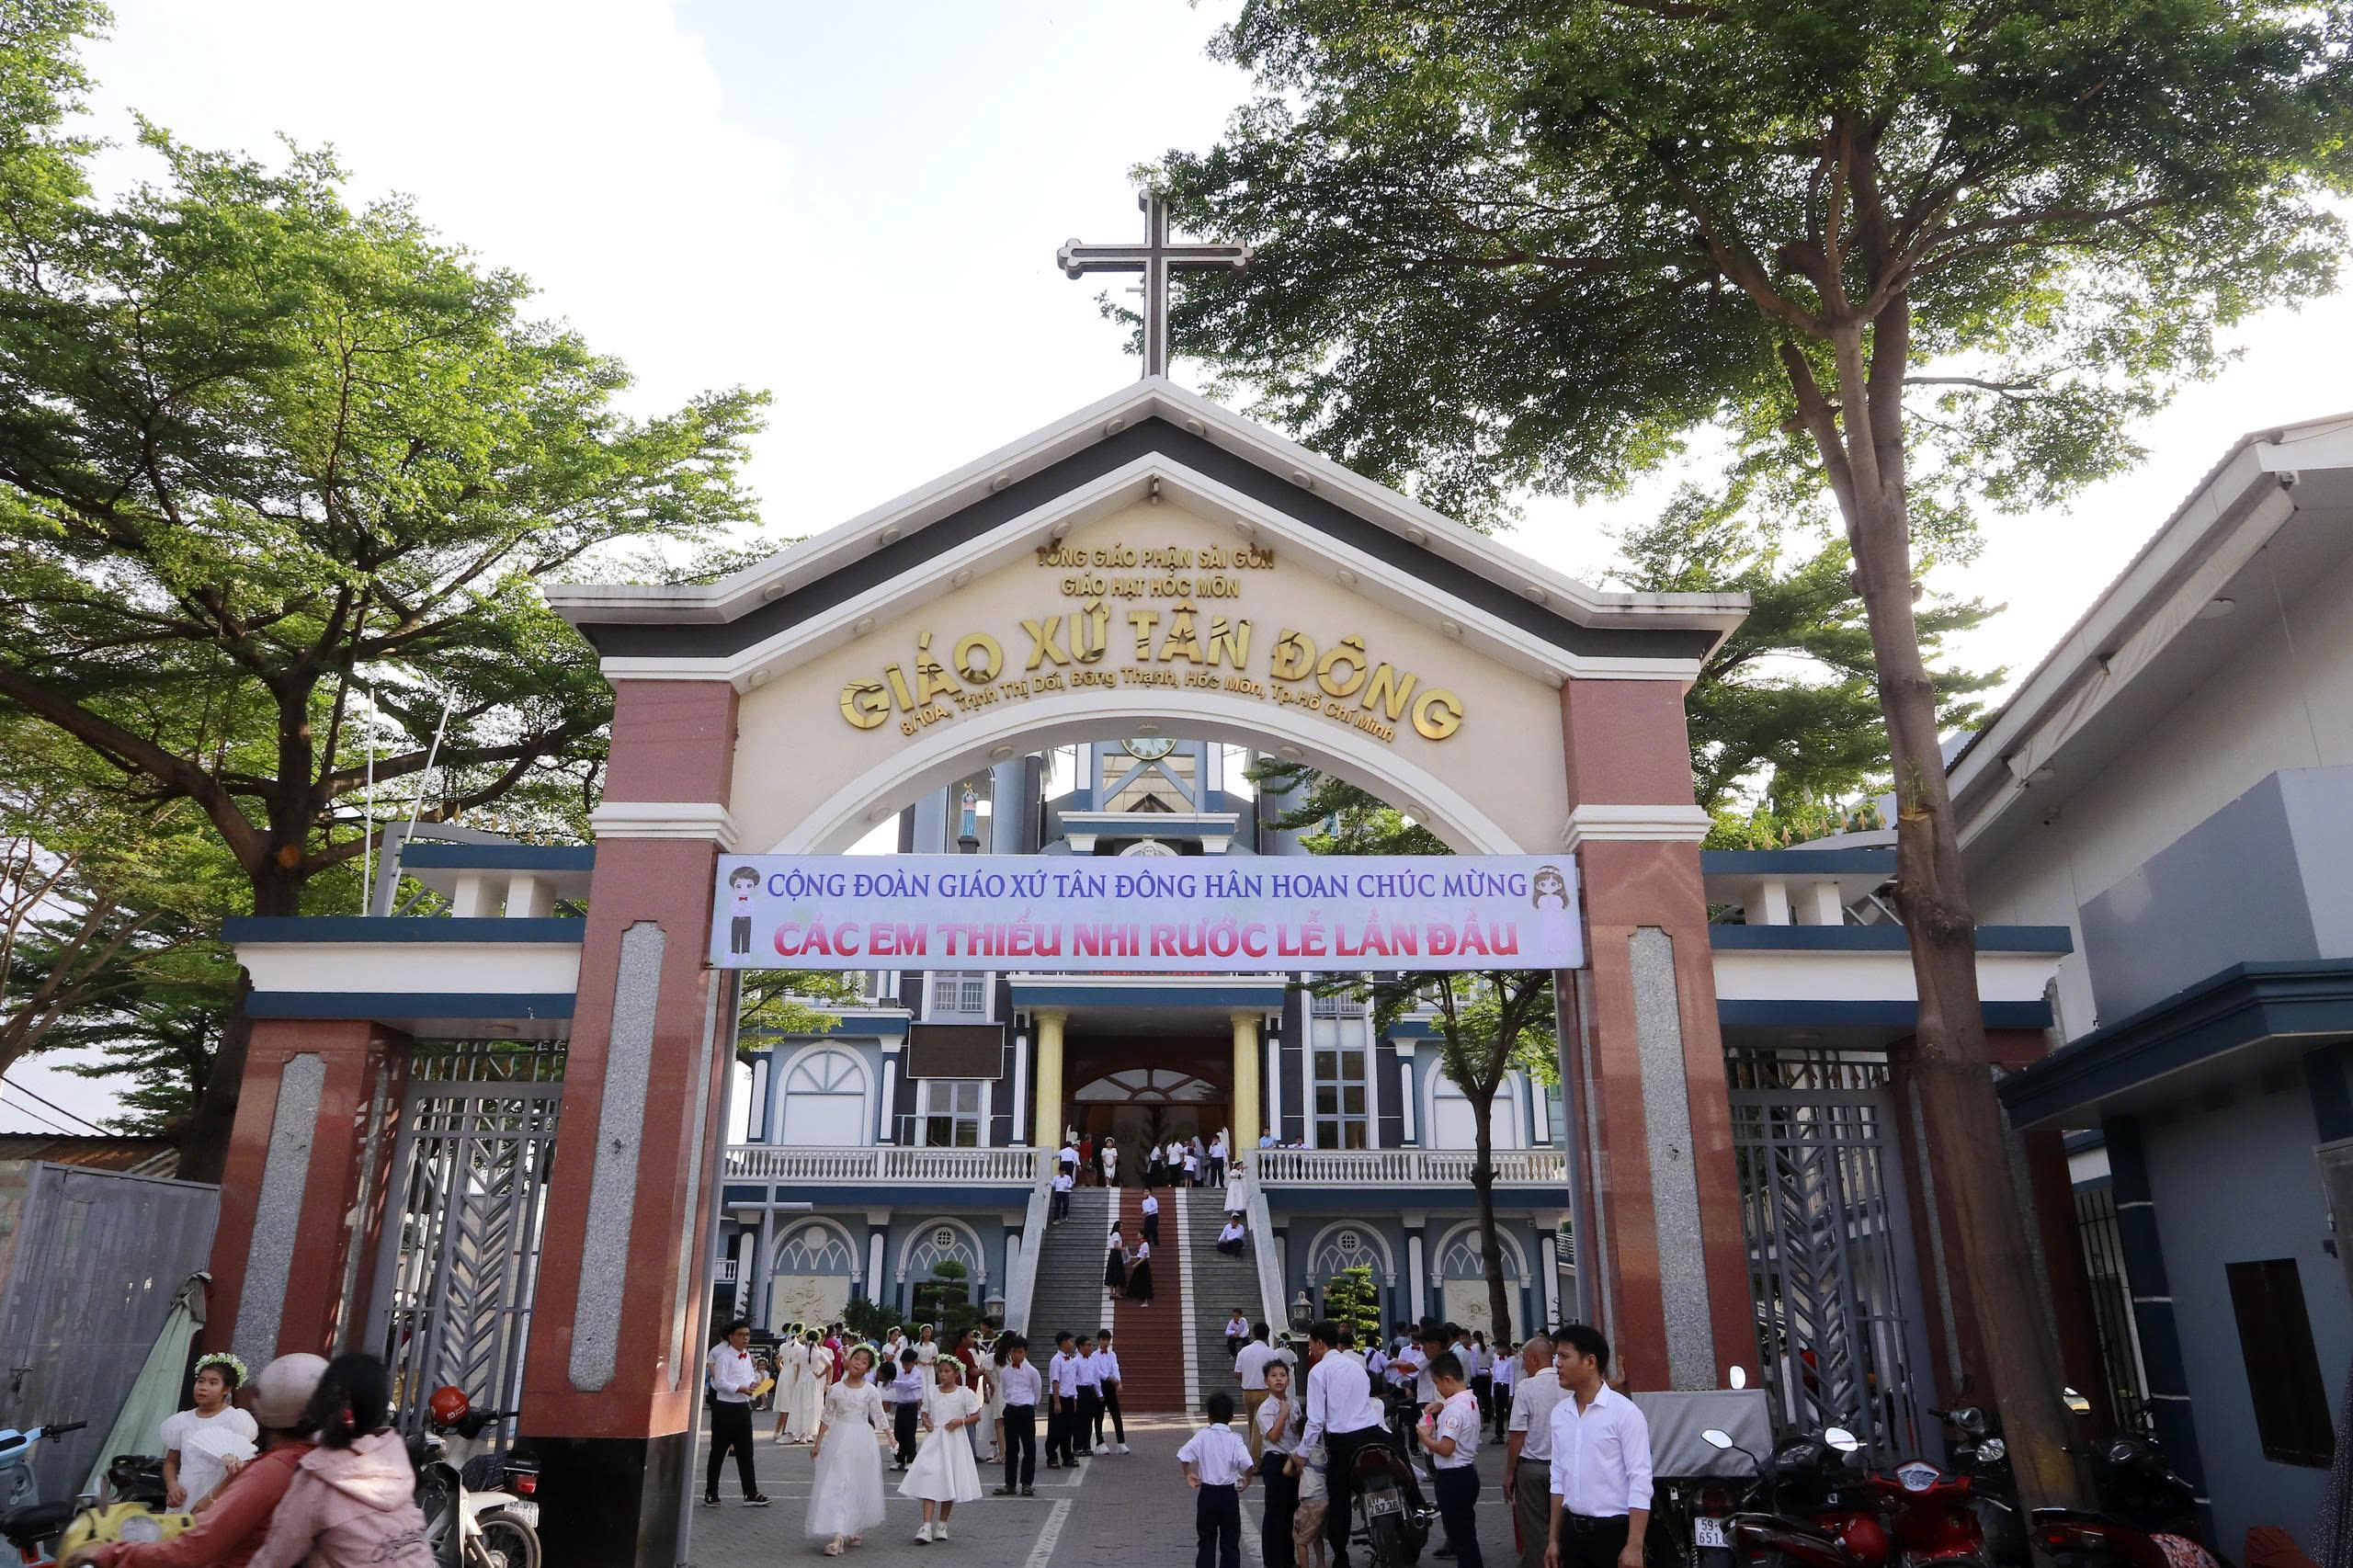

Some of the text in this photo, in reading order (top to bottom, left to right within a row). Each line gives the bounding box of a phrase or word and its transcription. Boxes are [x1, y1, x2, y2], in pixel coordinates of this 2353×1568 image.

[1092, 543, 1136, 567] GIÁO
[1142, 546, 1192, 571] PHẬN
[1199, 544, 1227, 569] SÀI
[1232, 543, 1274, 569] GÒN
[1061, 571, 1240, 600] GIÁO HẠT HÓC MÔN
[839, 597, 1464, 741] GIÁO XỨ TÂN ĐÔNG
[900, 704, 953, 736] 8/10A,
[954, 688, 998, 712] Trịnh
[1000, 680, 1029, 699] Thị
[1121, 667, 1179, 688] Thạnh,
[1224, 676, 1266, 699] Môn,
[1324, 701, 1358, 723] Chí
[1354, 714, 1395, 743] Minh
[767, 869, 1528, 902] CỘNG ĐOÀN GIÁO XỨ TÂN ĐÔNG HÂN HOAN CHÚC MỪNG
[773, 906, 1519, 957] CÁC EM THIẾU NHI RƯỚC LỄ LẦN ĐẦU
[1701, 1519, 1720, 1530] 59-
